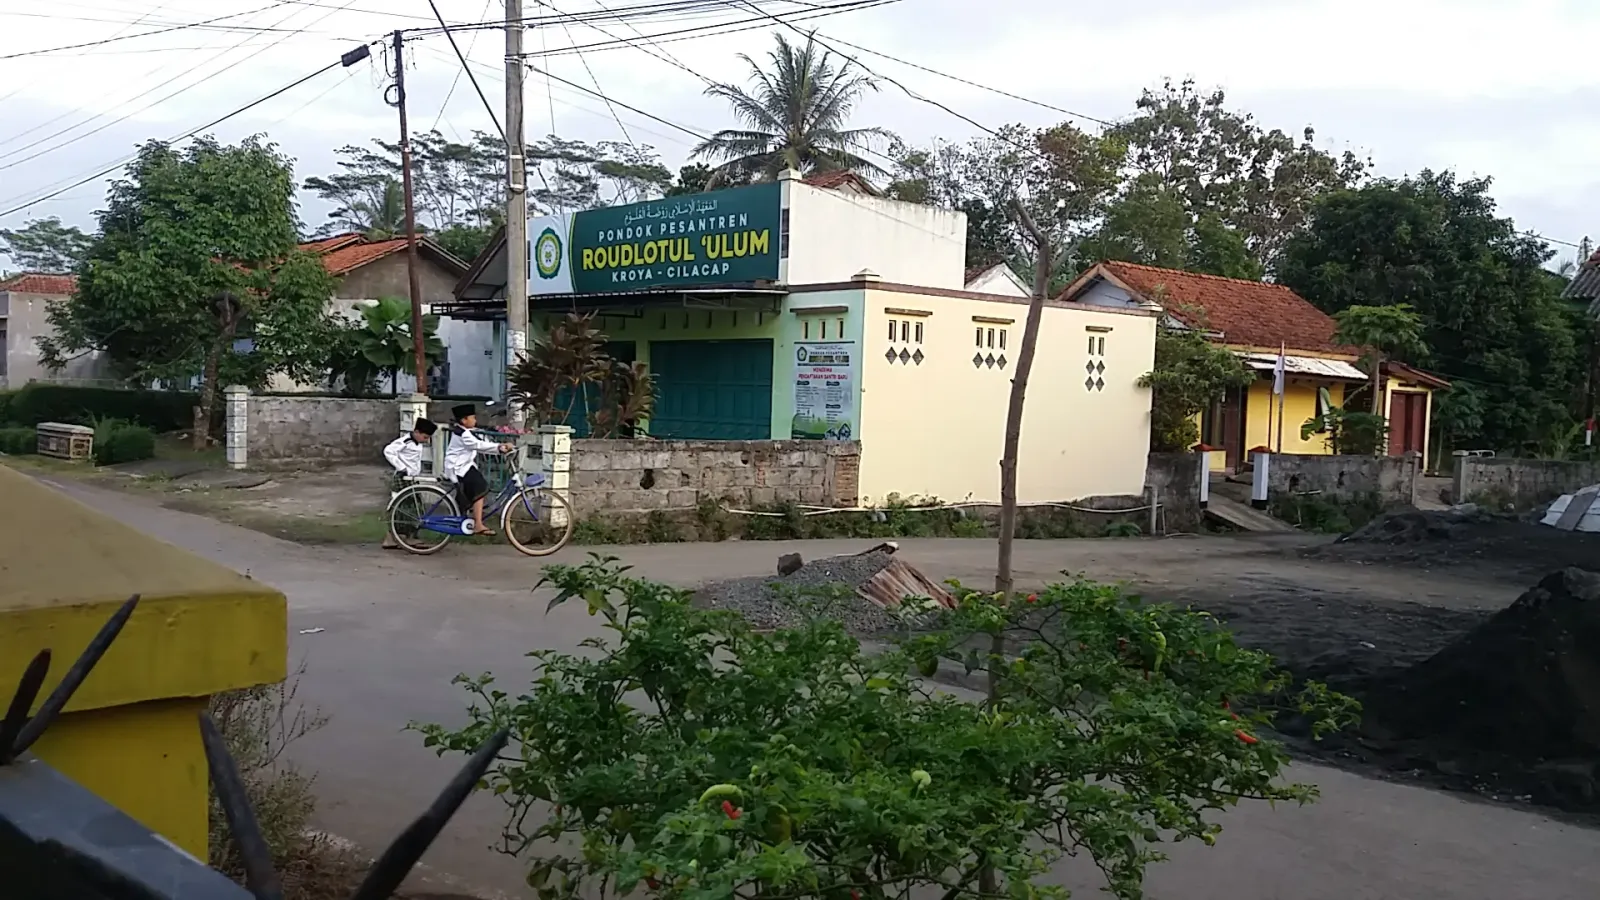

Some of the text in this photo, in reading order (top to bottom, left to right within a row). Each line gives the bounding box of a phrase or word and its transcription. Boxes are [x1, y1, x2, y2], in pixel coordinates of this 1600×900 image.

[598, 213, 748, 243] PONDOK PESANTREN
[582, 237, 695, 271] ROUDLOTUL
[612, 268, 653, 283] KROYA
[667, 262, 730, 278] CILACAP
